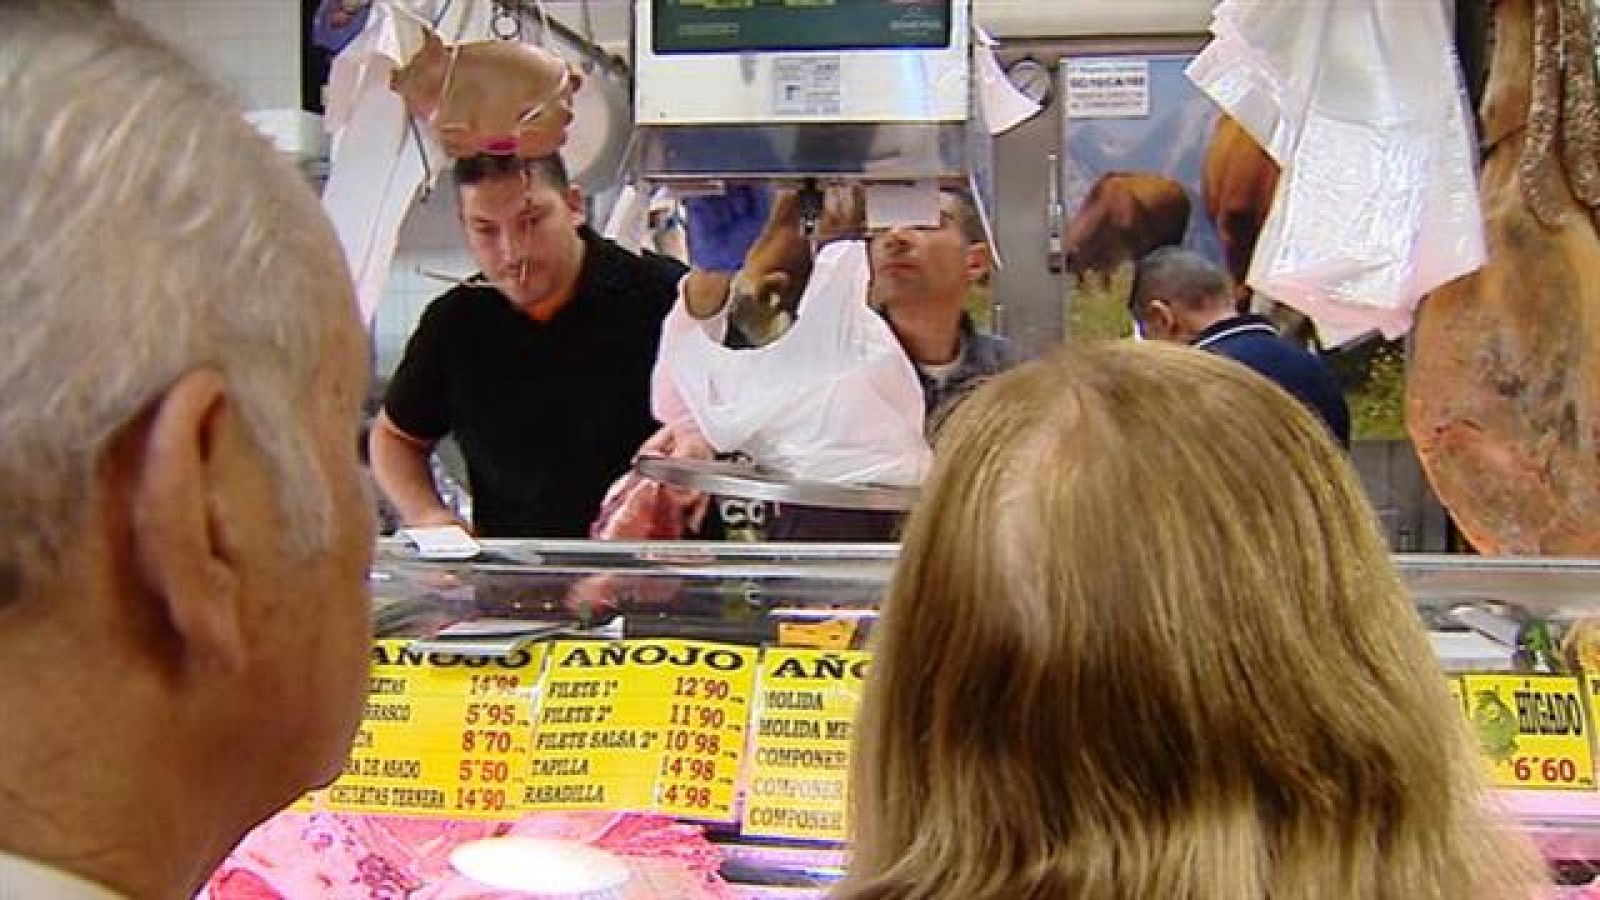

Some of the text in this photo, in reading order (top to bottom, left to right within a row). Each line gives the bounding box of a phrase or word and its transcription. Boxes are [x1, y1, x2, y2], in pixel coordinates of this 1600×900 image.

[559, 643, 743, 670] AÑOJO
[550, 681, 600, 699] FILETE
[541, 707, 594, 725] FILETE
[759, 719, 820, 740] MOLIDA
[535, 731, 585, 750] FILETE
[589, 730, 636, 749] SALSA
[532, 758, 588, 777] TAPILLA
